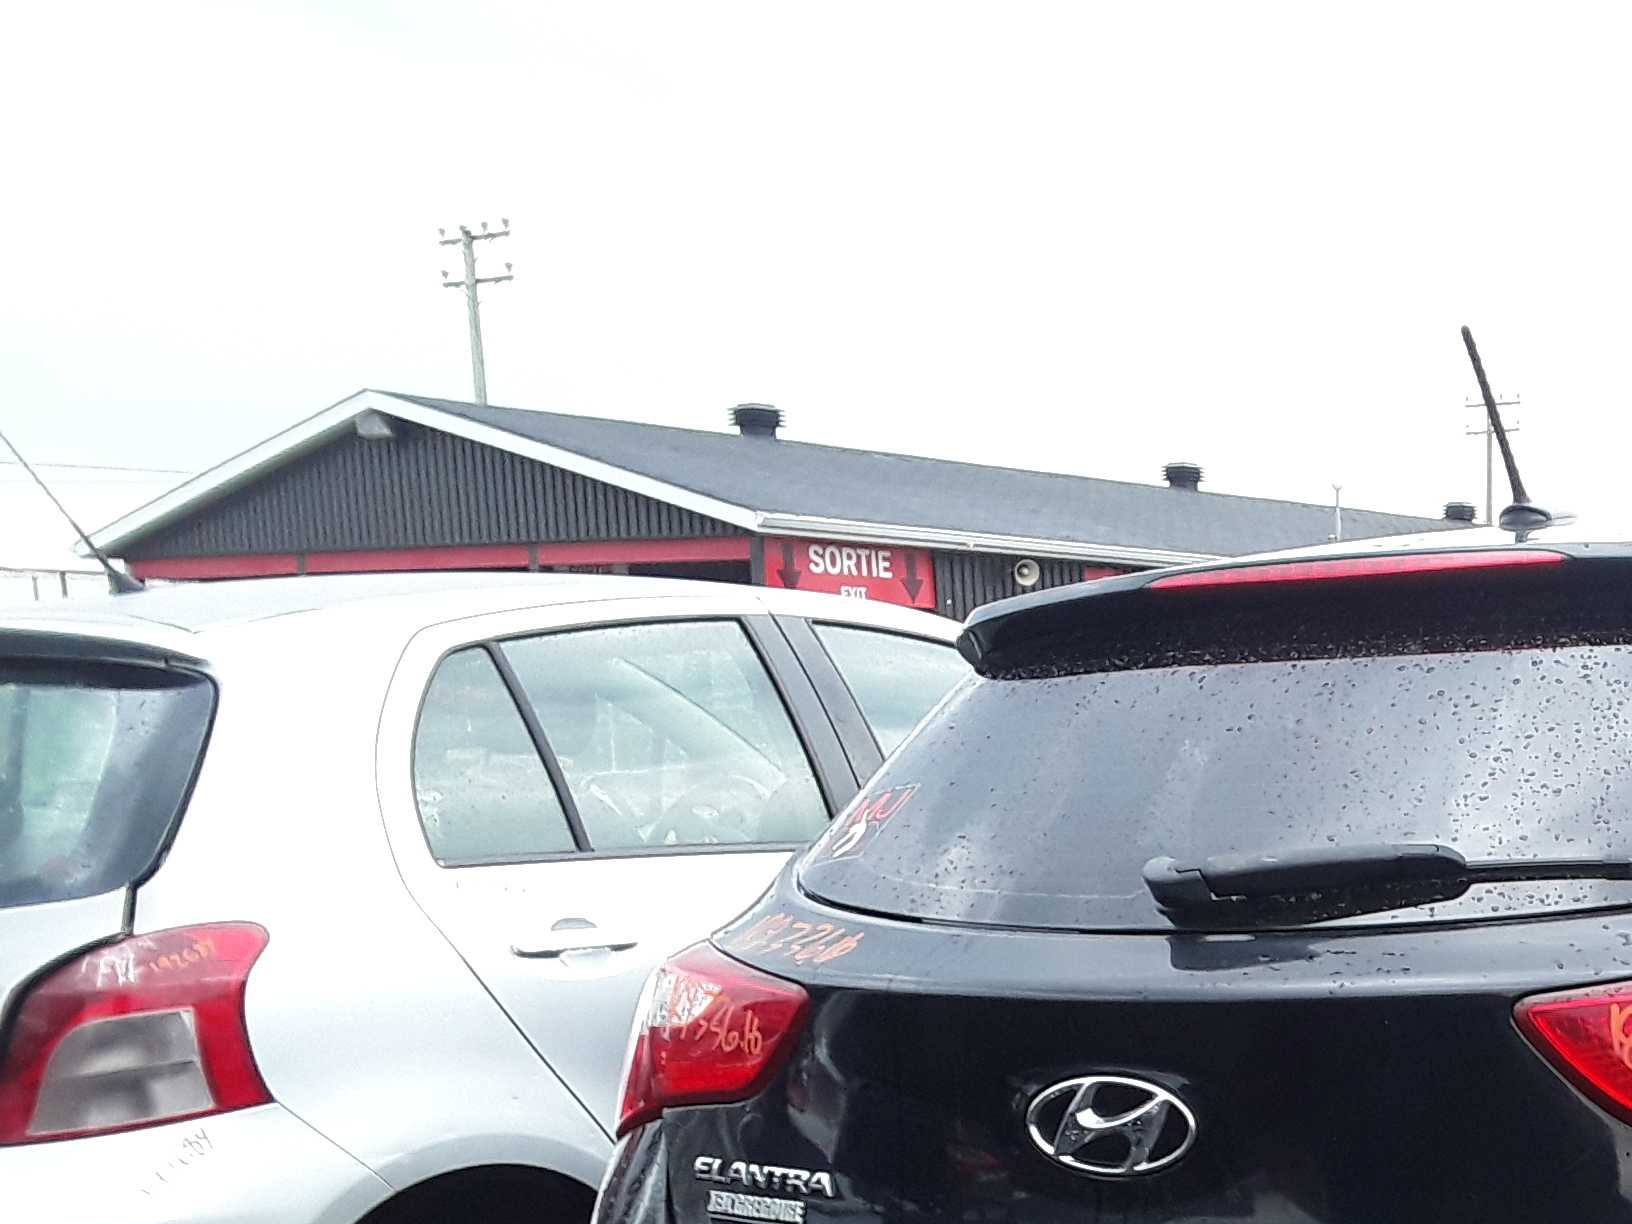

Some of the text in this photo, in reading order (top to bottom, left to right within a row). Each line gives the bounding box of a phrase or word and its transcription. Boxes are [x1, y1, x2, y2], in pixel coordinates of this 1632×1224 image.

[808, 543, 894, 579] SORTIE
[840, 585, 868, 600] EXIT
[693, 1155, 835, 1198] ELANTRA
